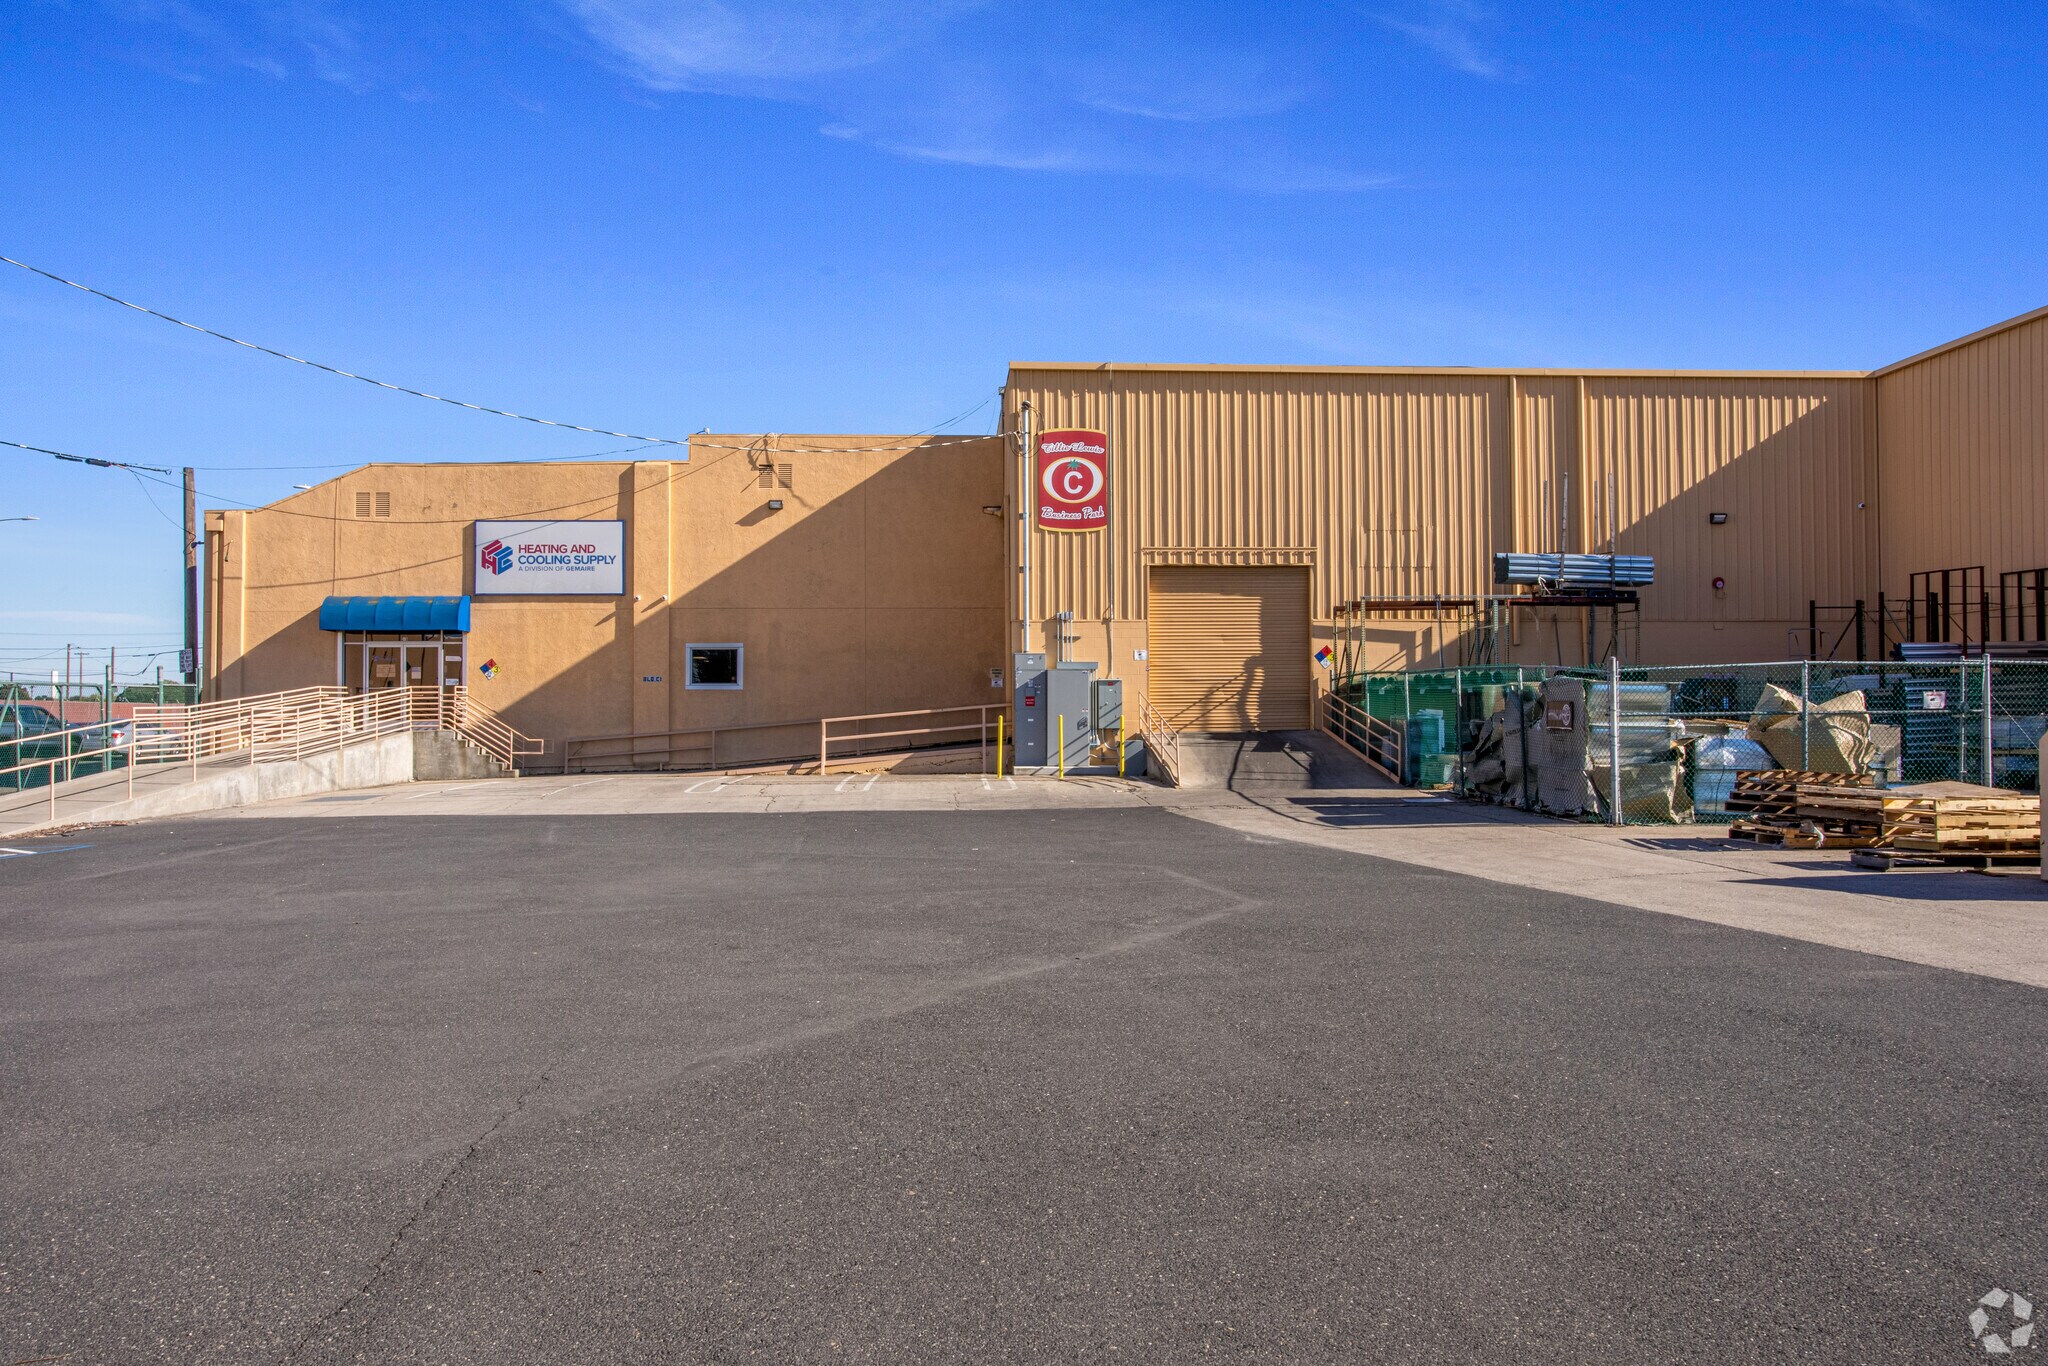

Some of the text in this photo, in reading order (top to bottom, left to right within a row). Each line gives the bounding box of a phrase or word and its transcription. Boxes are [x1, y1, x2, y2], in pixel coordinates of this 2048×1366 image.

[1071, 442, 1105, 454] Lewis
[1063, 471, 1083, 494] C
[1041, 505, 1105, 520] Business Park
[518, 544, 596, 554] HEATING AND
[517, 555, 617, 565] COOLING SUPPLY
